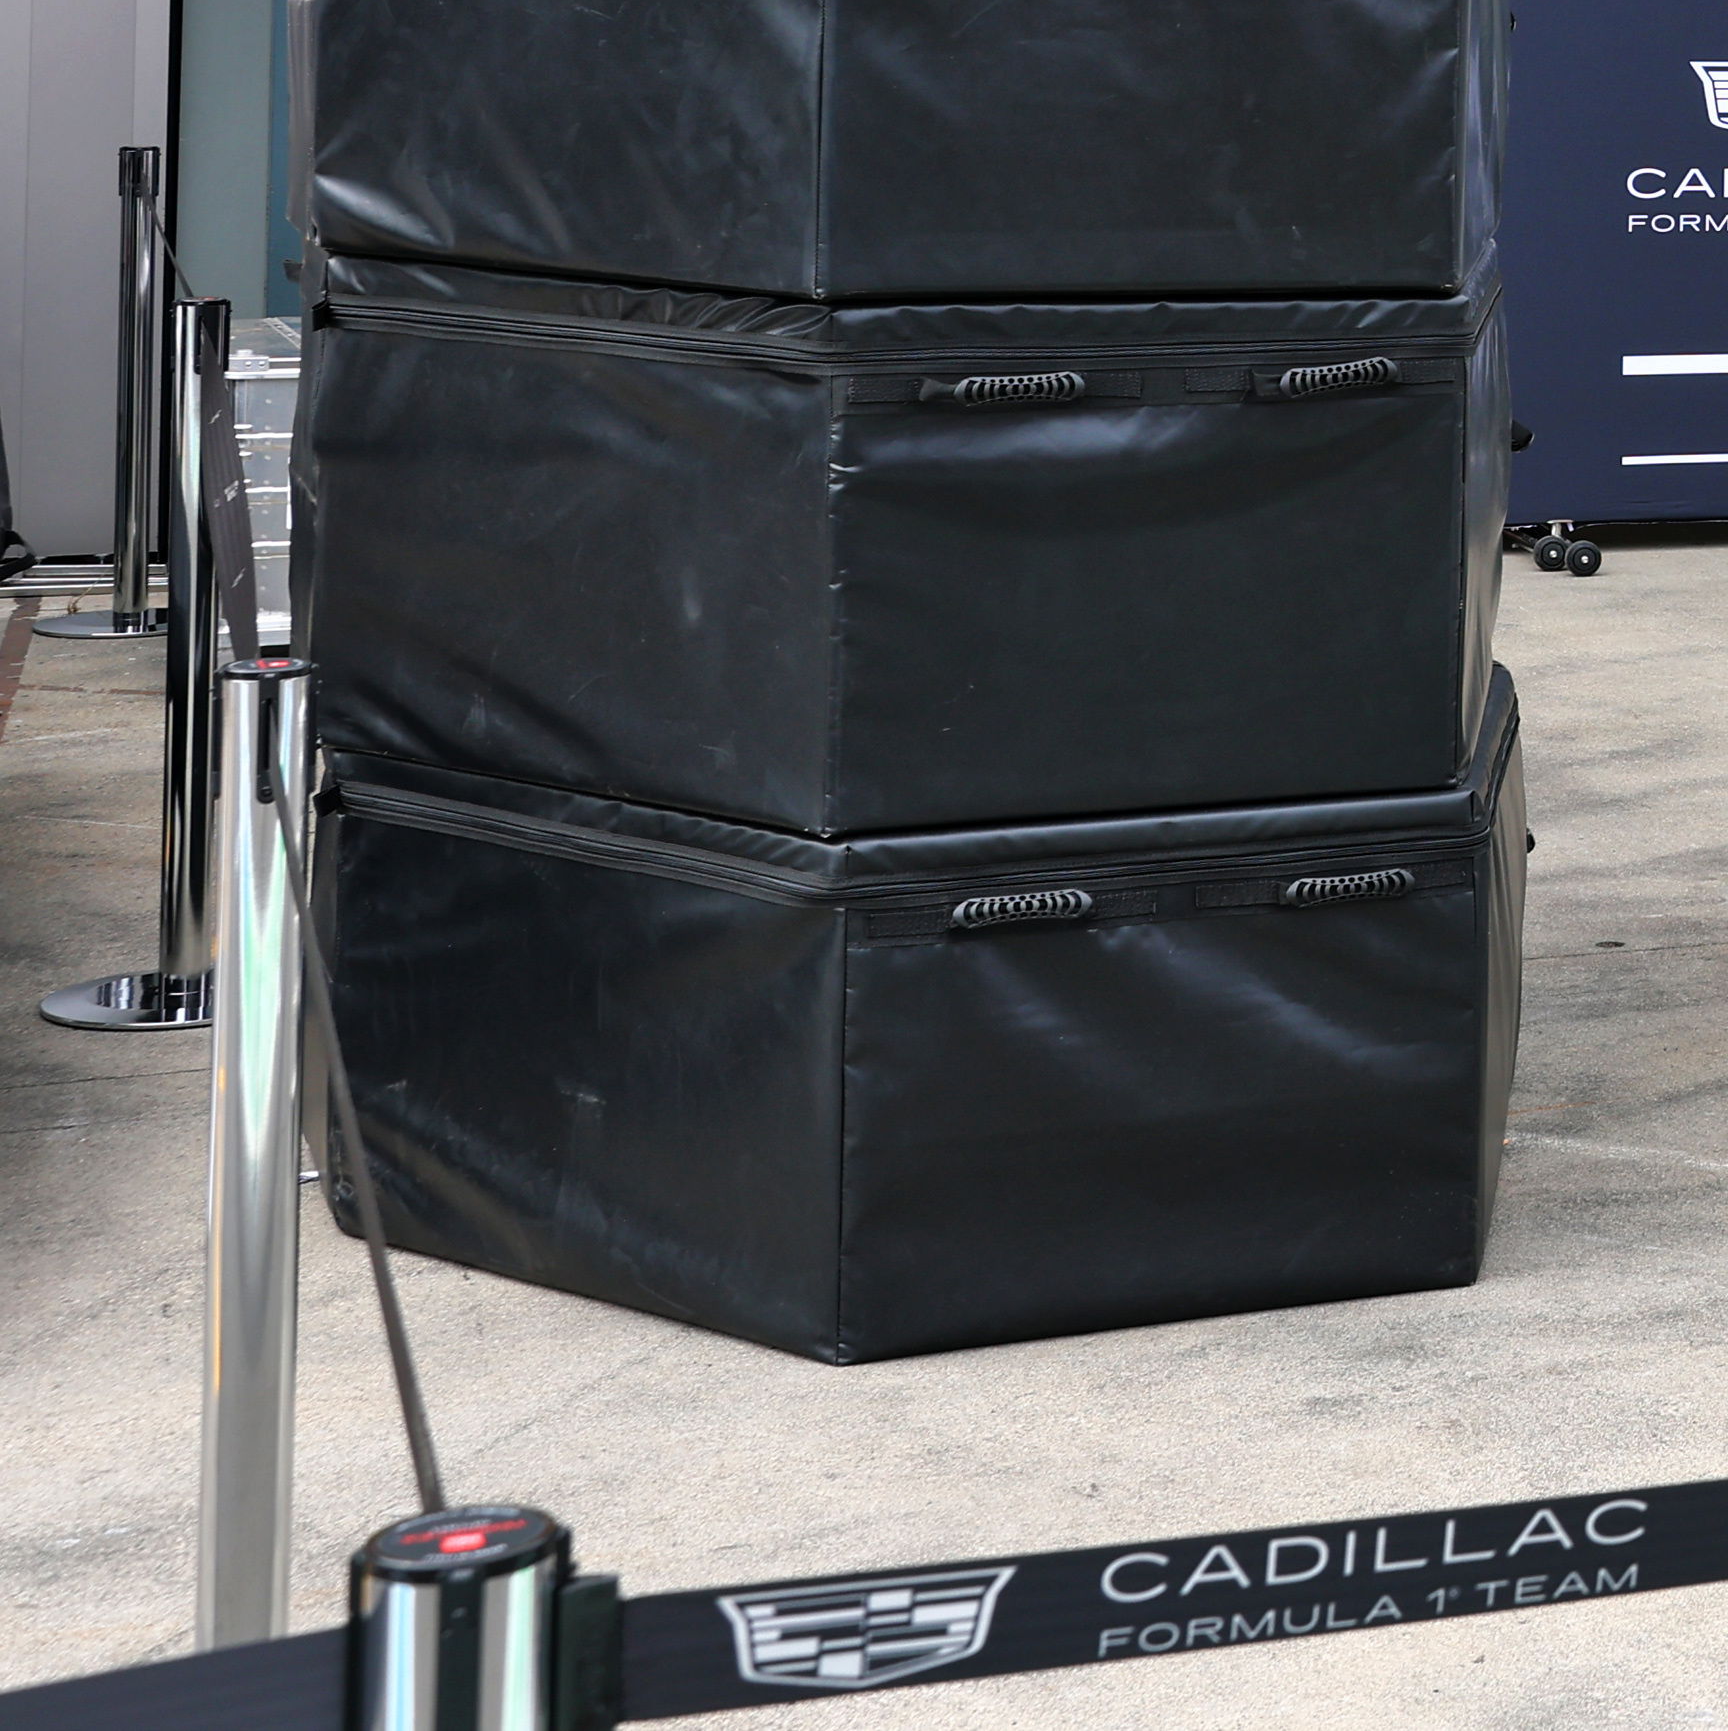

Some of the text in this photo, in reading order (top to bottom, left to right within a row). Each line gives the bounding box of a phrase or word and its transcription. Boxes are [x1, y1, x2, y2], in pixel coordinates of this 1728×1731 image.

[1099, 1498, 1648, 1606] CADILLAC
[1097, 1593, 1401, 1658] FORMULA
[1485, 1563, 1639, 1609] TEAM
